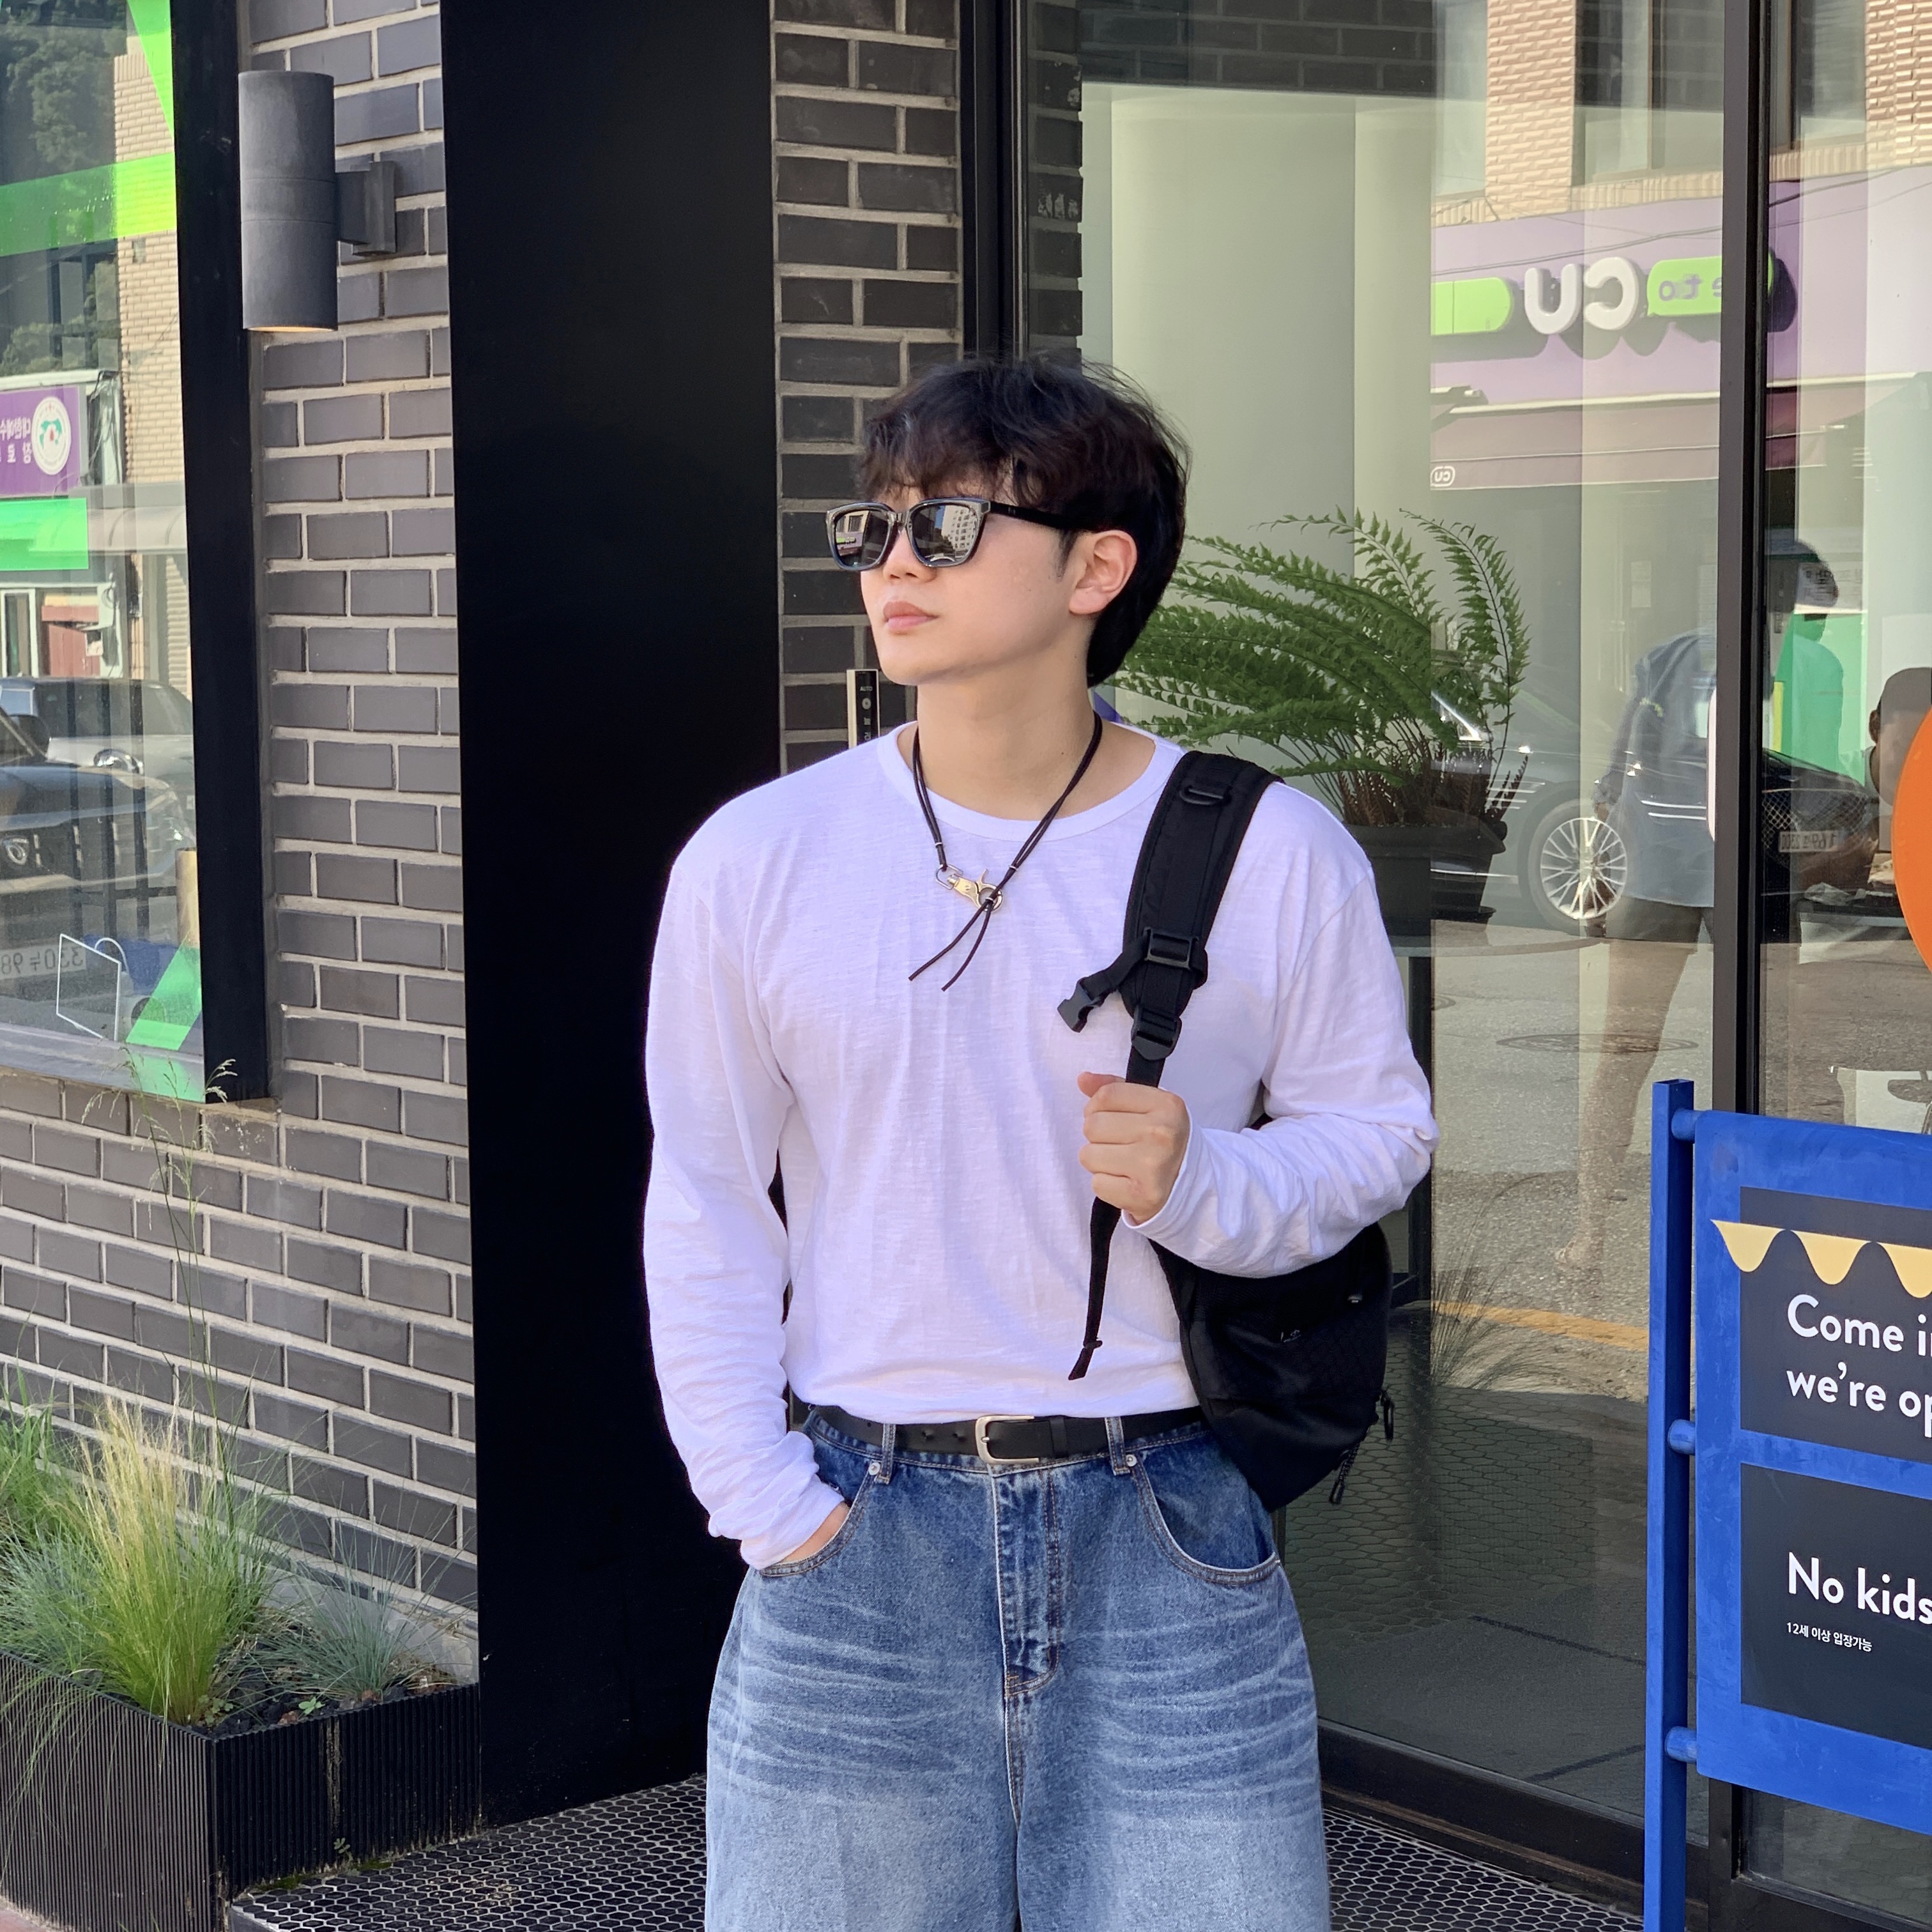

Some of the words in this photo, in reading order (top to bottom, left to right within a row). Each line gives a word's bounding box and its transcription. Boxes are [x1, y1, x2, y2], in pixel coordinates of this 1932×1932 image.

[1788, 1294, 1905, 1352] Come
[1917, 1314, 1932, 1358] i
[1786, 1361, 1886, 1412] we're
[1789, 1551, 1844, 1604] No
[1858, 1567, 1932, 1625] kids
[1787, 1622, 1809, 1638] 12세
[1811, 1627, 1831, 1643] 이상
[1833, 1632, 1873, 1652] 입장가능
